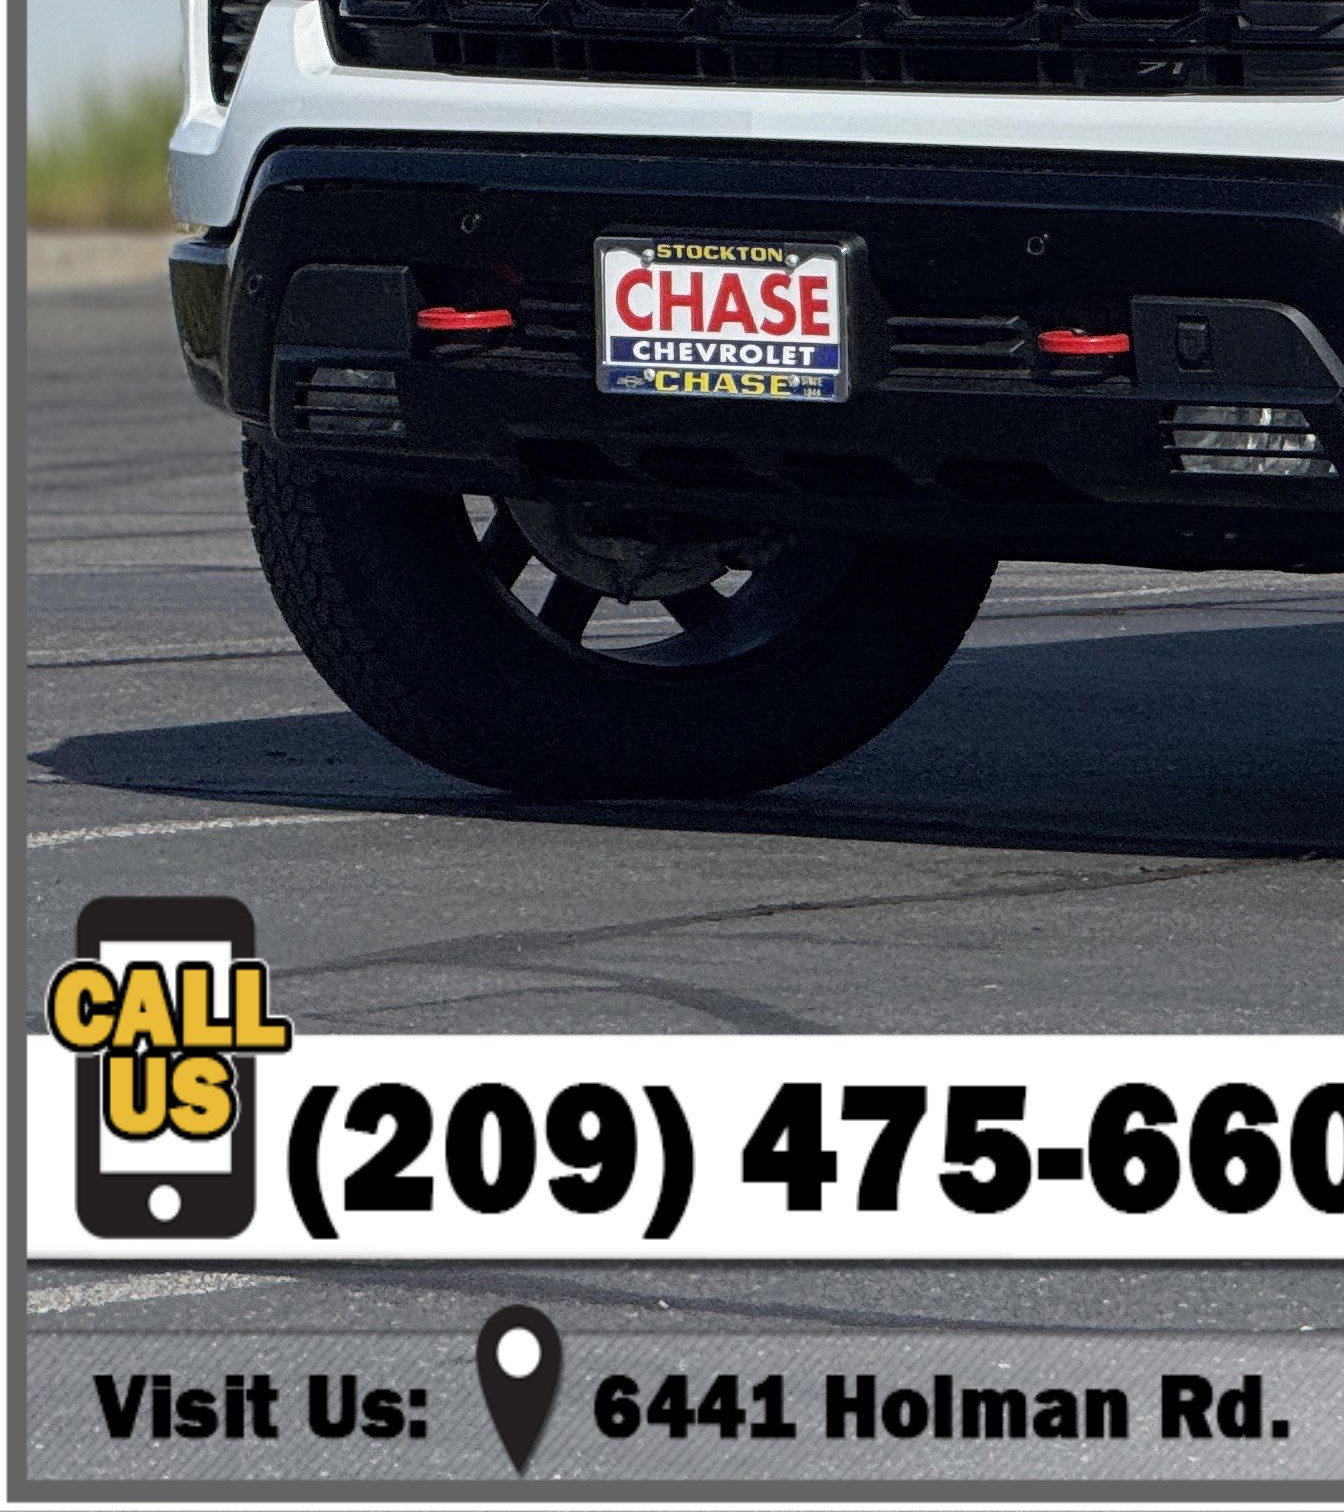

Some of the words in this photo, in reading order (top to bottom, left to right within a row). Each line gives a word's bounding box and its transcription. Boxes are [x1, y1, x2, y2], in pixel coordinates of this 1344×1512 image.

[656, 244, 784, 263] STOCKTON
[615, 268, 830, 337] CHASE
[632, 341, 816, 366] CHEVROLET
[654, 370, 792, 397] CHASE
